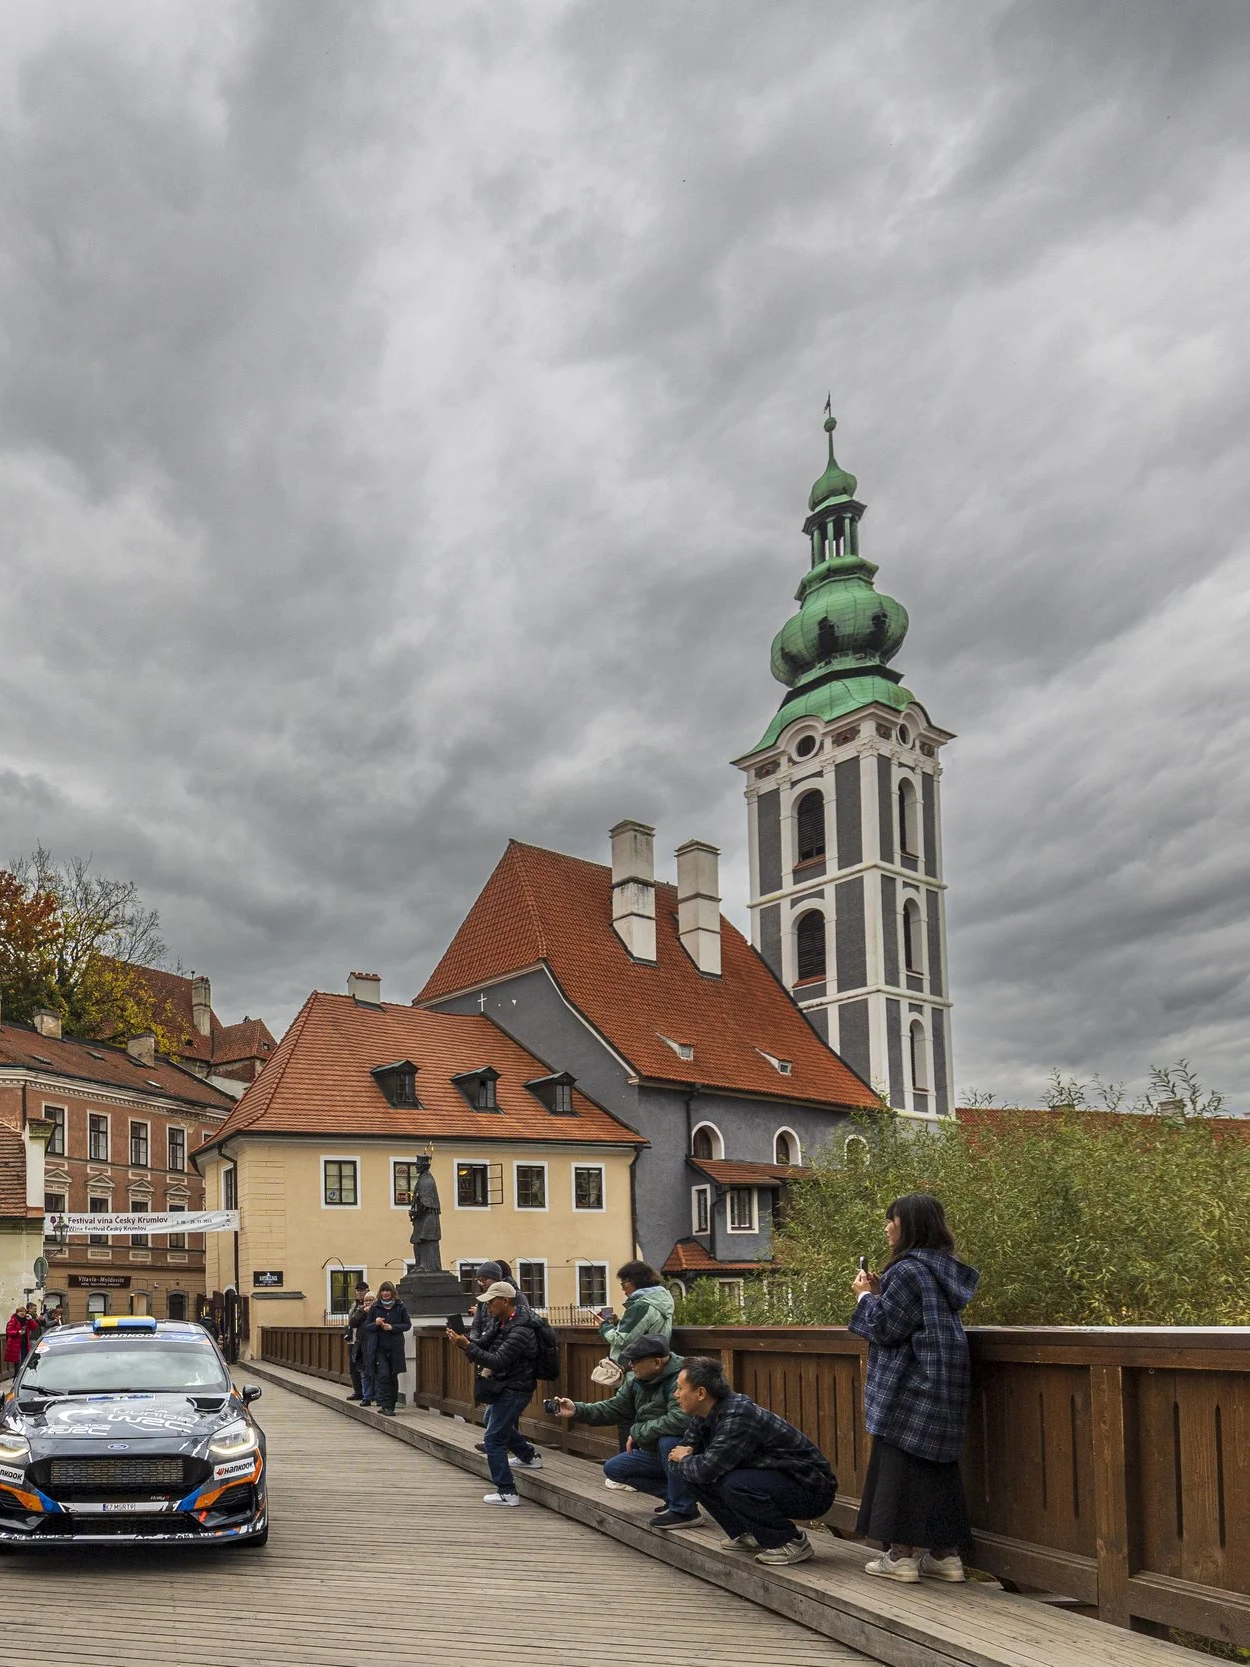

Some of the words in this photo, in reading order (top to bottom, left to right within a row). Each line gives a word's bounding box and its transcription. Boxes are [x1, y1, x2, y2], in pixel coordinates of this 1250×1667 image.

[115, 1216, 136, 1225] Český
[138, 1216, 168, 1224] Krumlov
[107, 1413, 195, 1434] WRC
